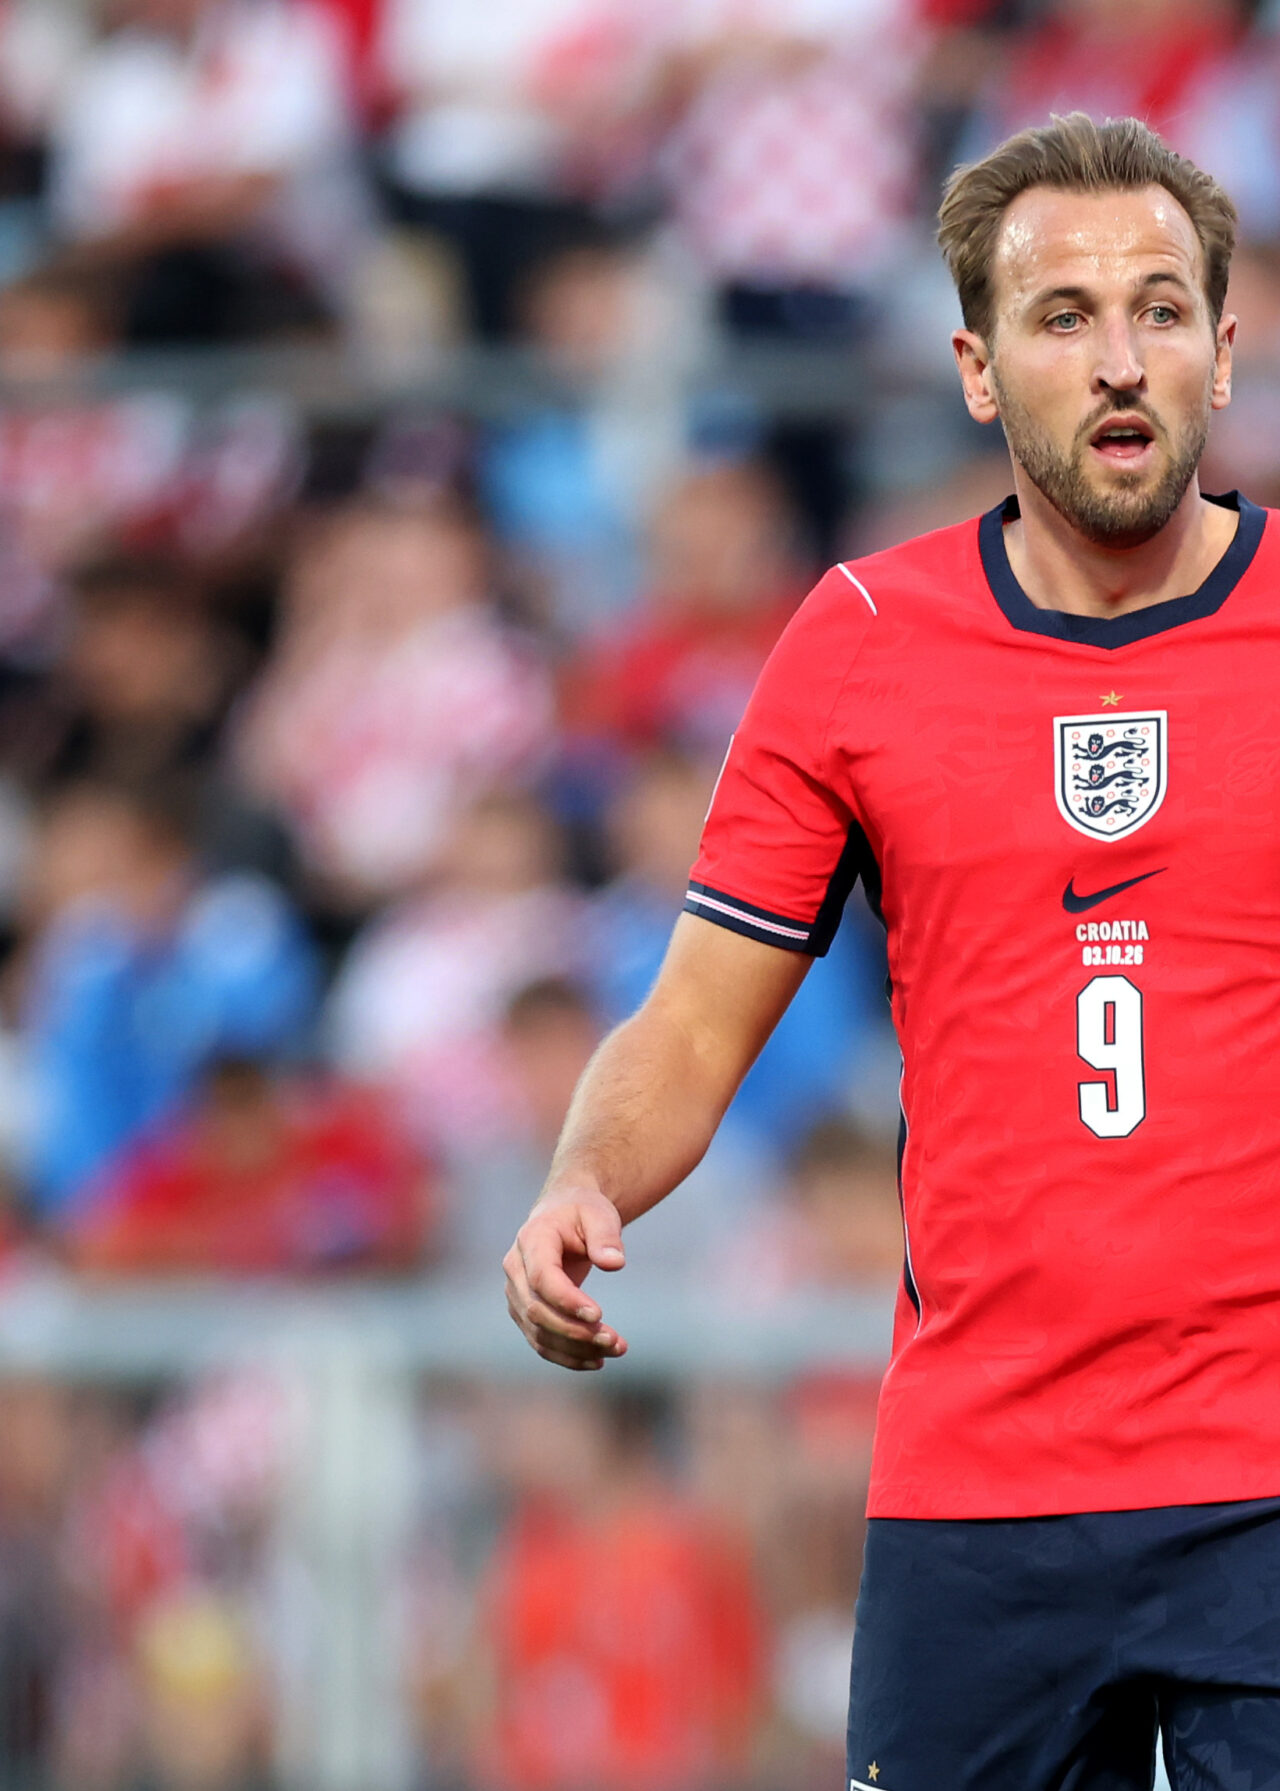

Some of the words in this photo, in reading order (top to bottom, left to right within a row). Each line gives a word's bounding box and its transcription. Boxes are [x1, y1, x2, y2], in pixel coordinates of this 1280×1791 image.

[1075, 920, 1149, 942] CROATIA
[1082, 945, 1144, 966] 03.10.26
[1077, 975, 1146, 1139] 9
